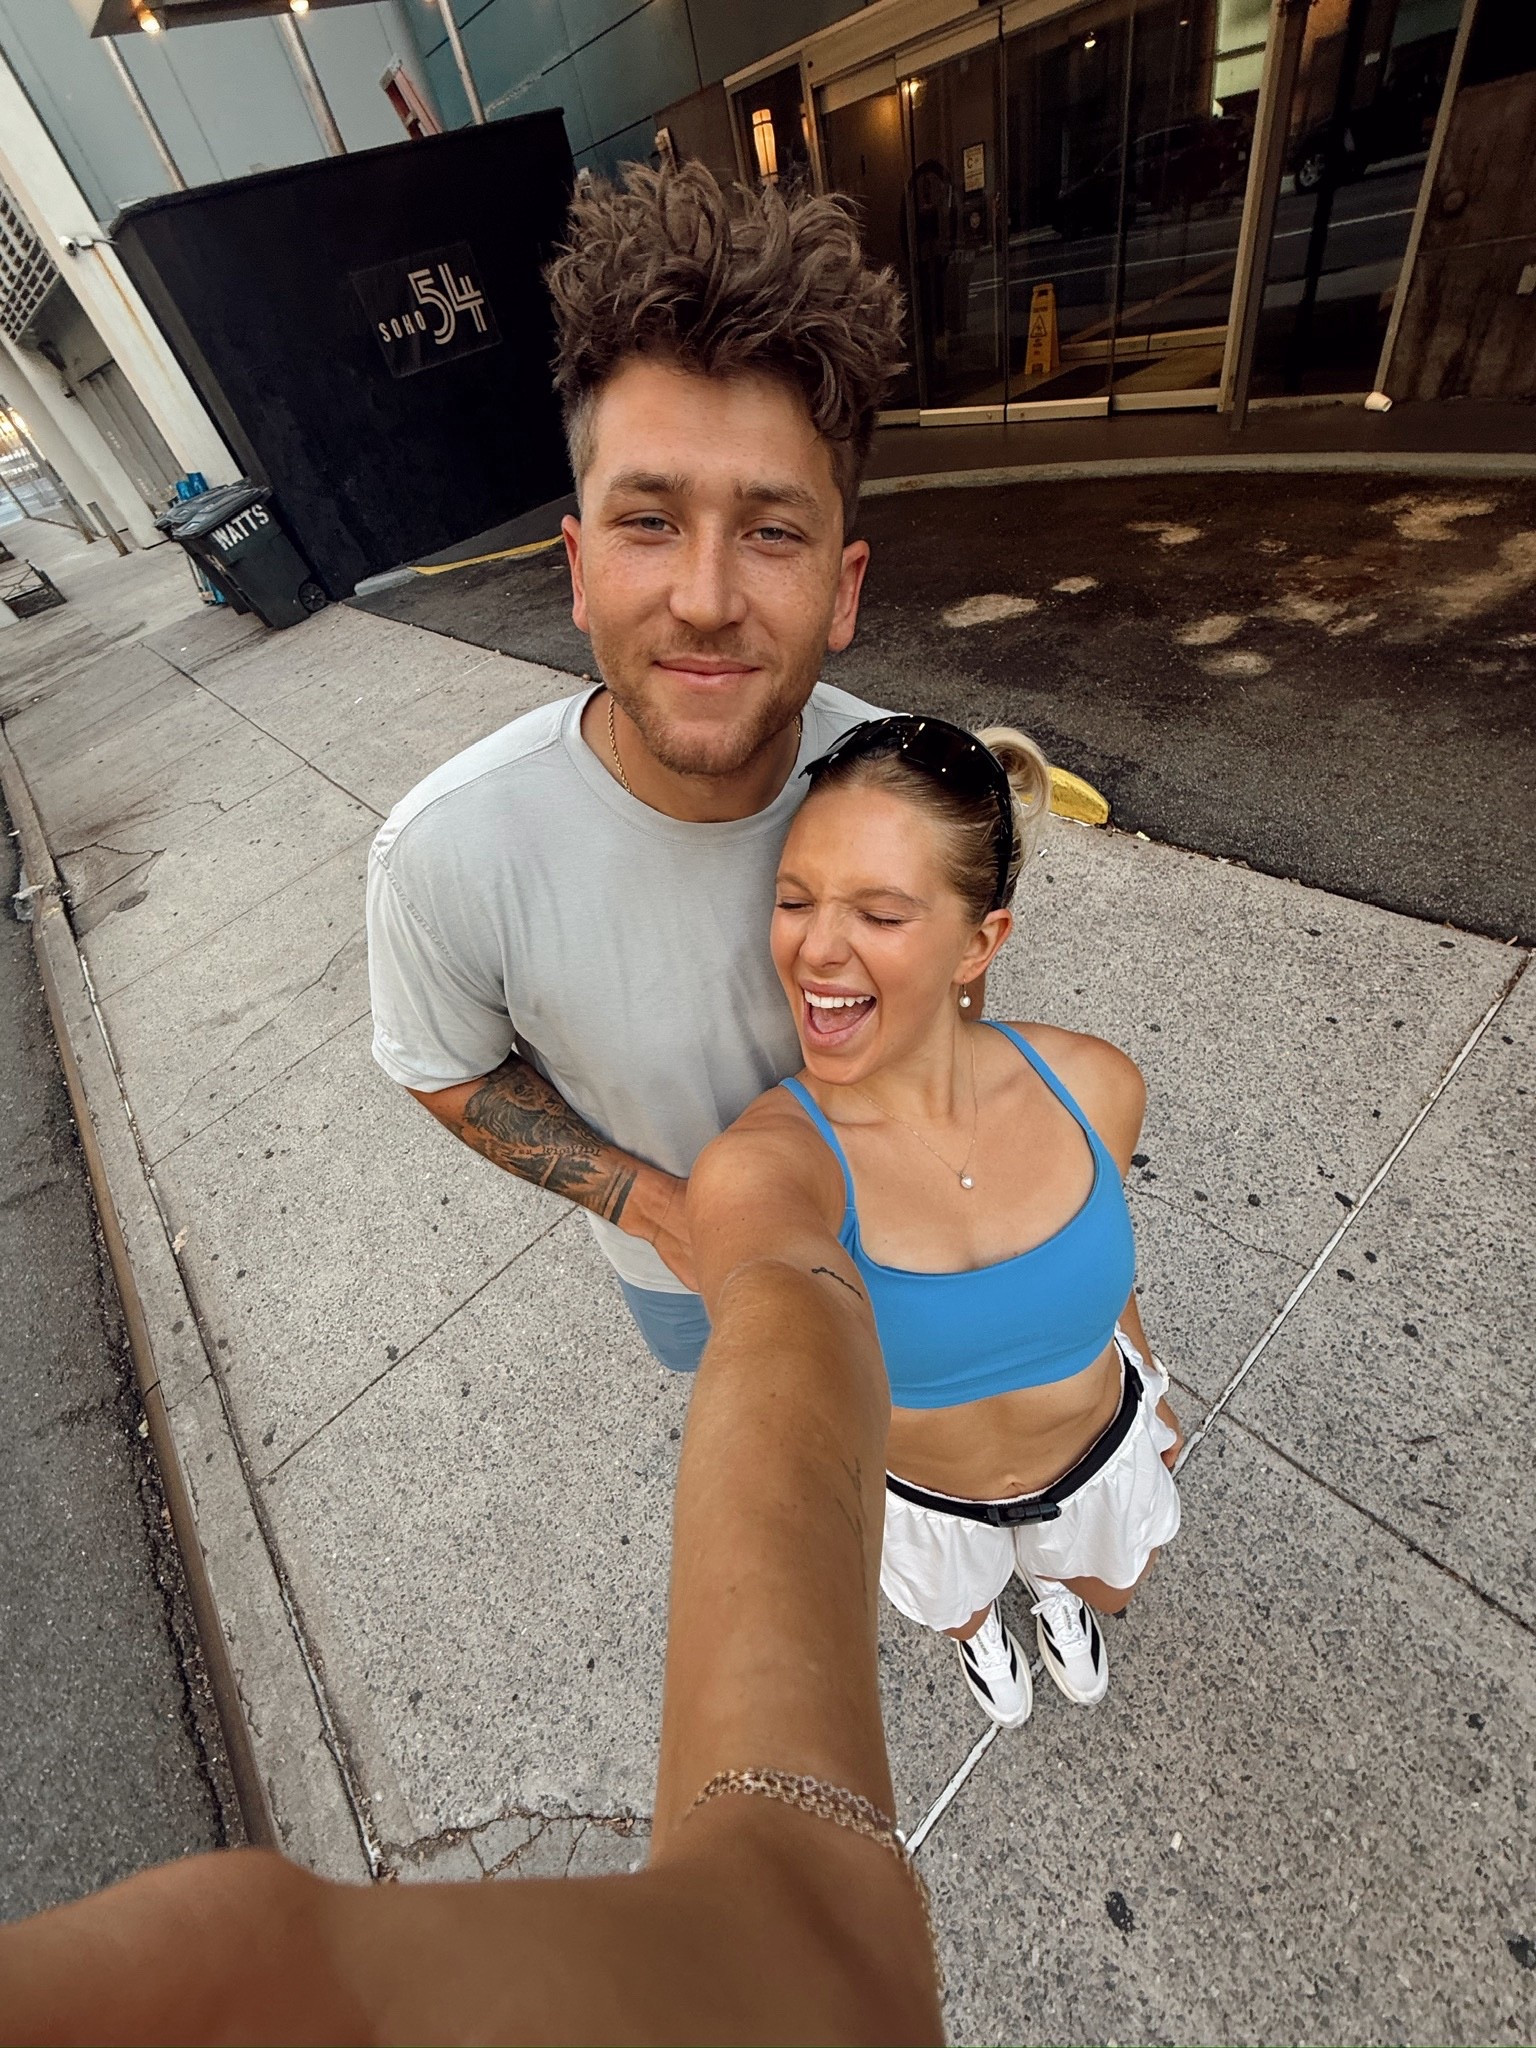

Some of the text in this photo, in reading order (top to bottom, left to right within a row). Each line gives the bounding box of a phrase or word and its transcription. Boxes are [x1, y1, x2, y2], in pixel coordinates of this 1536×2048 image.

[378, 263, 488, 345] SOHO 54
[211, 503, 270, 551] WATTS
